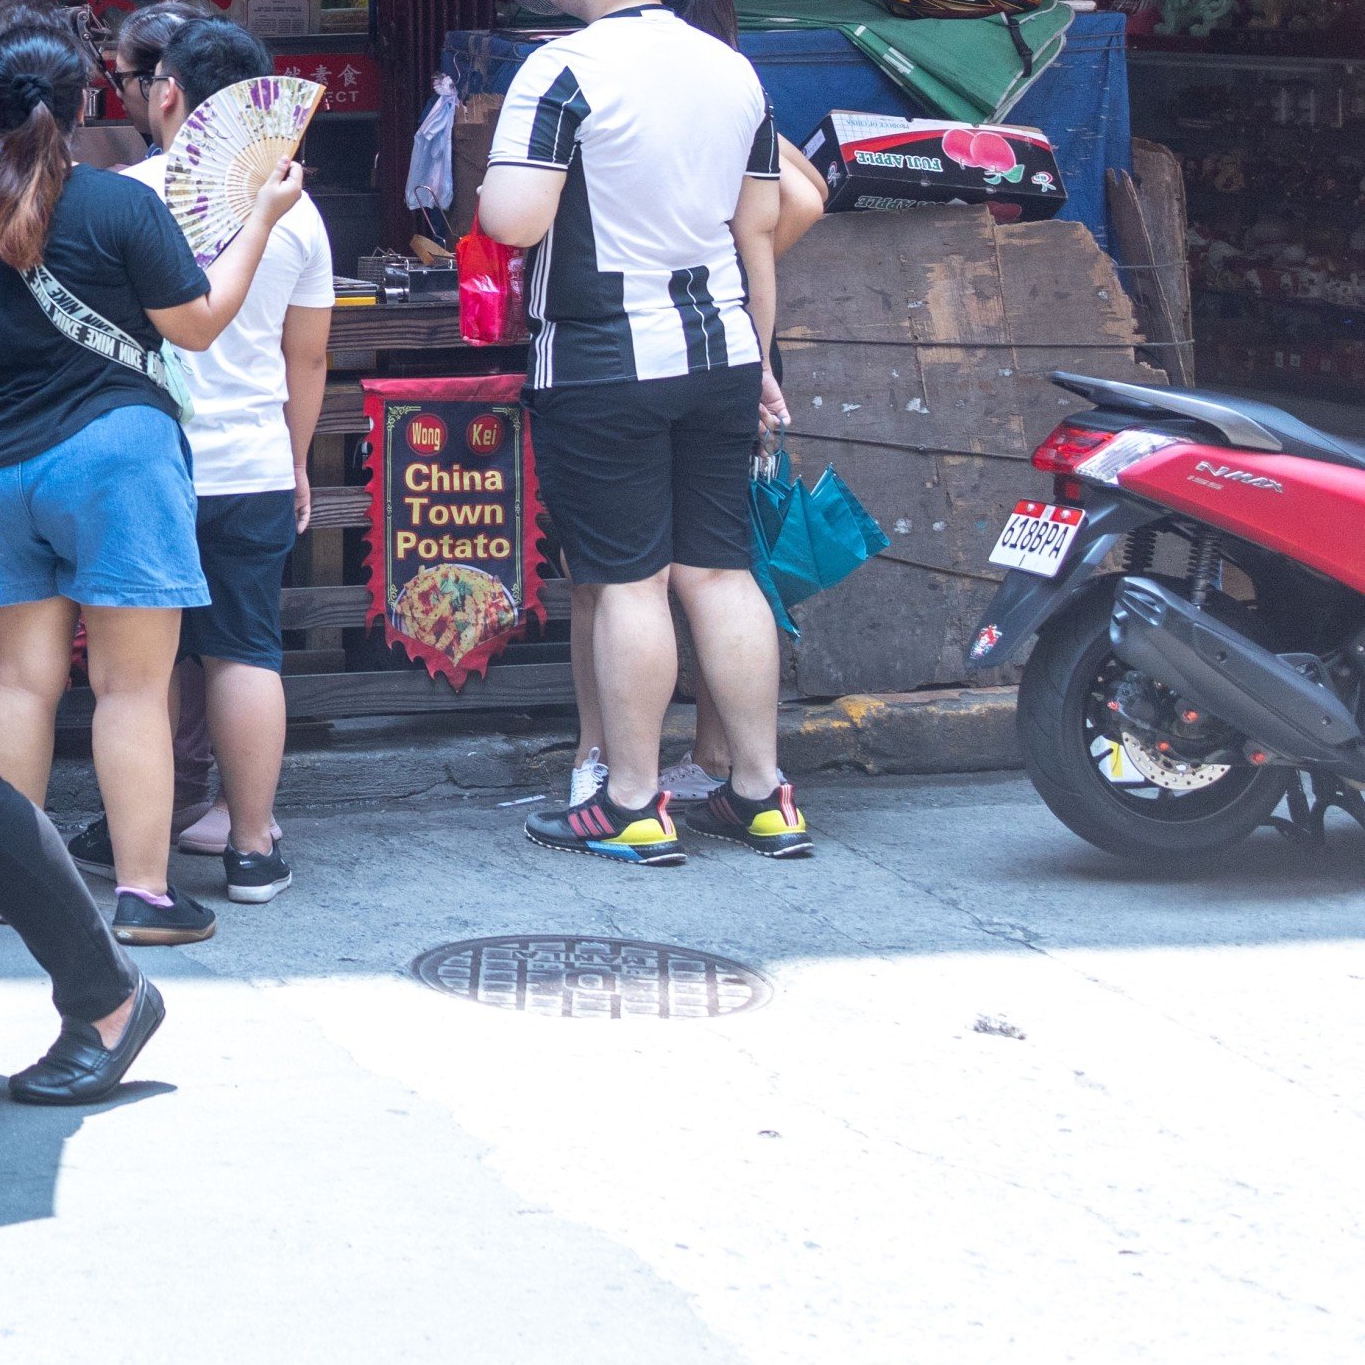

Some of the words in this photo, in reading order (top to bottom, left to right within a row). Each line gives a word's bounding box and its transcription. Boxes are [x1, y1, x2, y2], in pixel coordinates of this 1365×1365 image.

[854, 150, 903, 168] APPLE
[906, 154, 943, 172] FUJI
[412, 422, 441, 450] Wong
[473, 423, 496, 446] Kei
[404, 463, 503, 491] China
[1195, 461, 1283, 493] NMAX
[404, 497, 503, 525] Town
[397, 531, 510, 560] Potato
[1001, 515, 1072, 560] 618BPA
